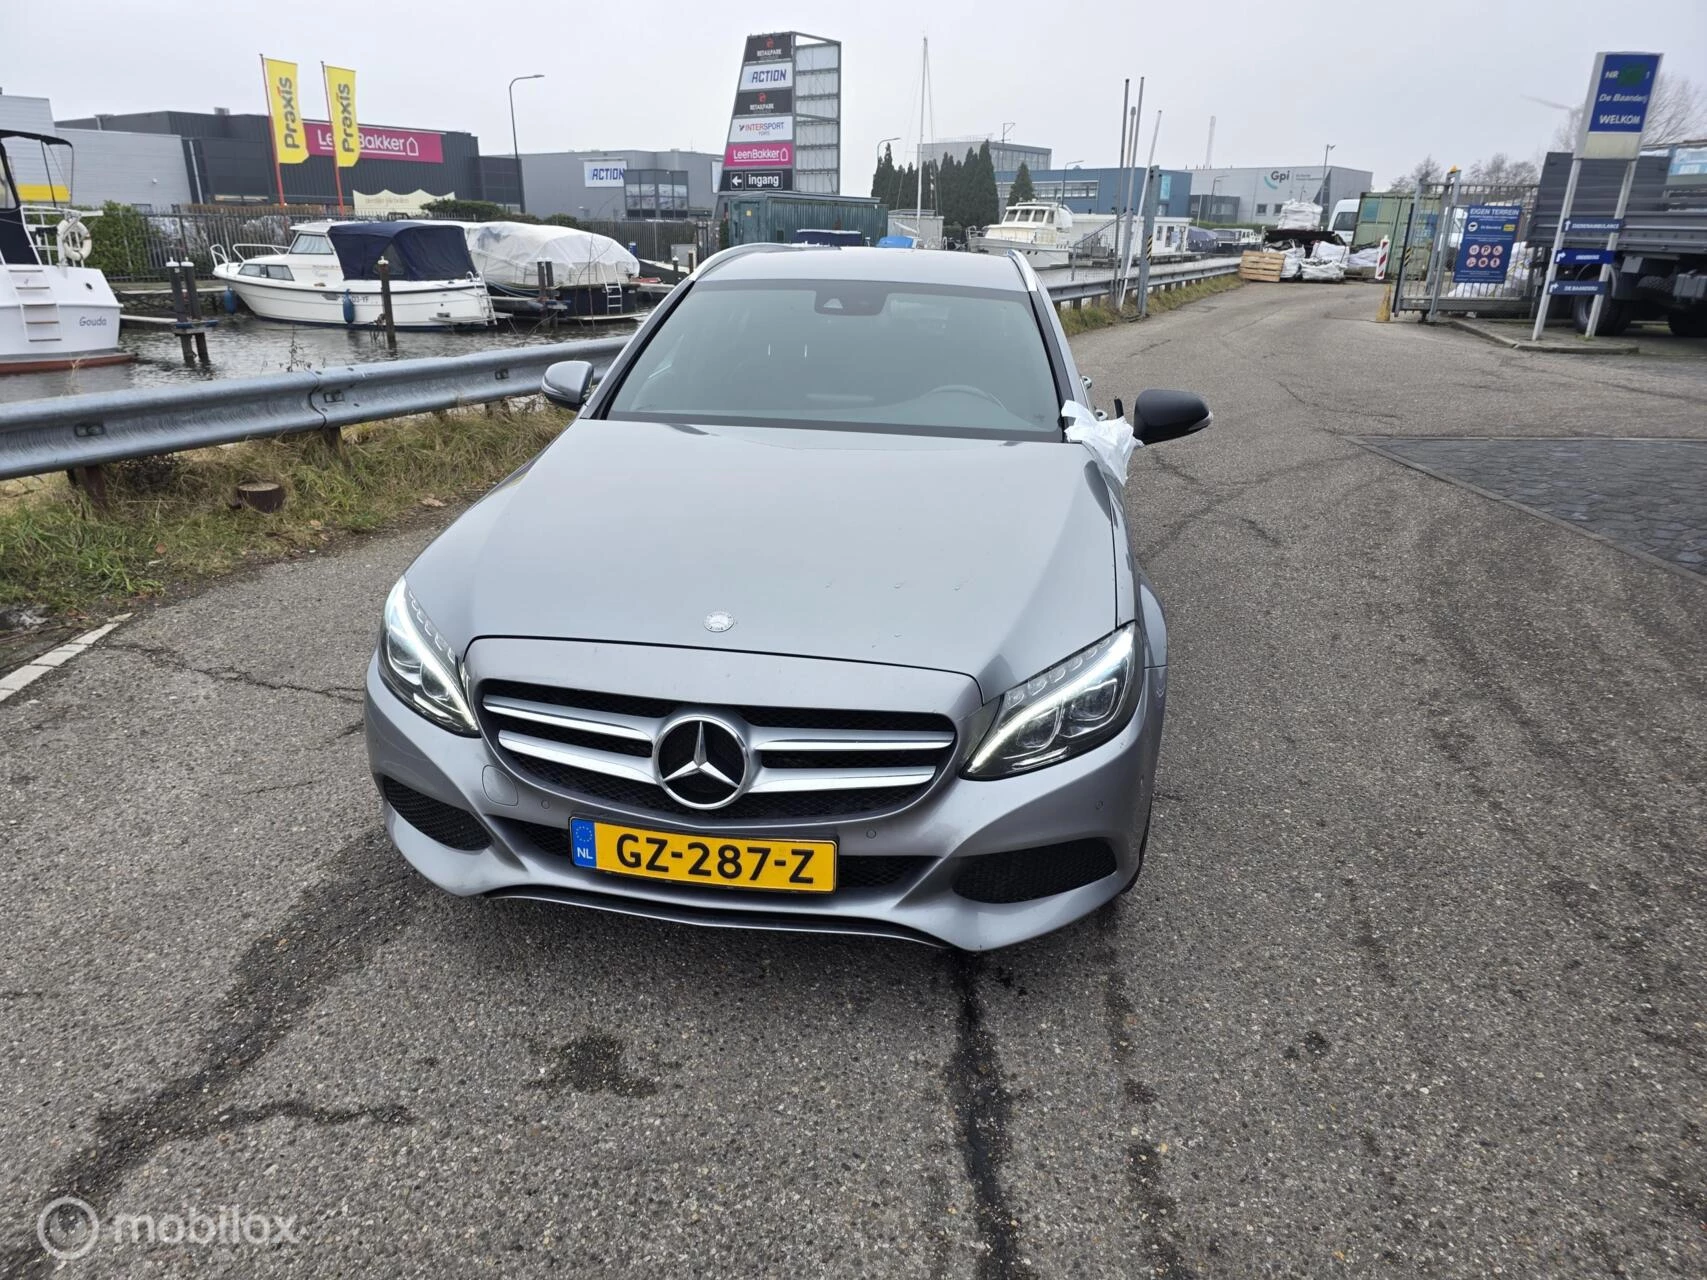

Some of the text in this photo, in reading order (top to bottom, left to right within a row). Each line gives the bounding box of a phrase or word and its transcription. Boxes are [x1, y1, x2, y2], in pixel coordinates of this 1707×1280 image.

[751, 69, 787, 83] ACTION
[1599, 93, 1611, 102] De
[276, 76, 300, 150] Praxis
[335, 83, 355, 153] Praxis
[1599, 114, 1641, 125] WELKOM
[744, 121, 785, 132] INTERSPORT
[317, 129, 405, 151] LeBakker
[733, 149, 780, 160] LeenBakker
[591, 167, 626, 181] ACTION
[748, 174, 779, 188] ingang
[1270, 170, 1290, 183] Gpi
[1470, 208, 1520, 216] EIGEN TERREIN
[79, 315, 107, 327] Gouda
[577, 846, 593, 860] NL
[616, 833, 815, 884] GZ-287-Z
